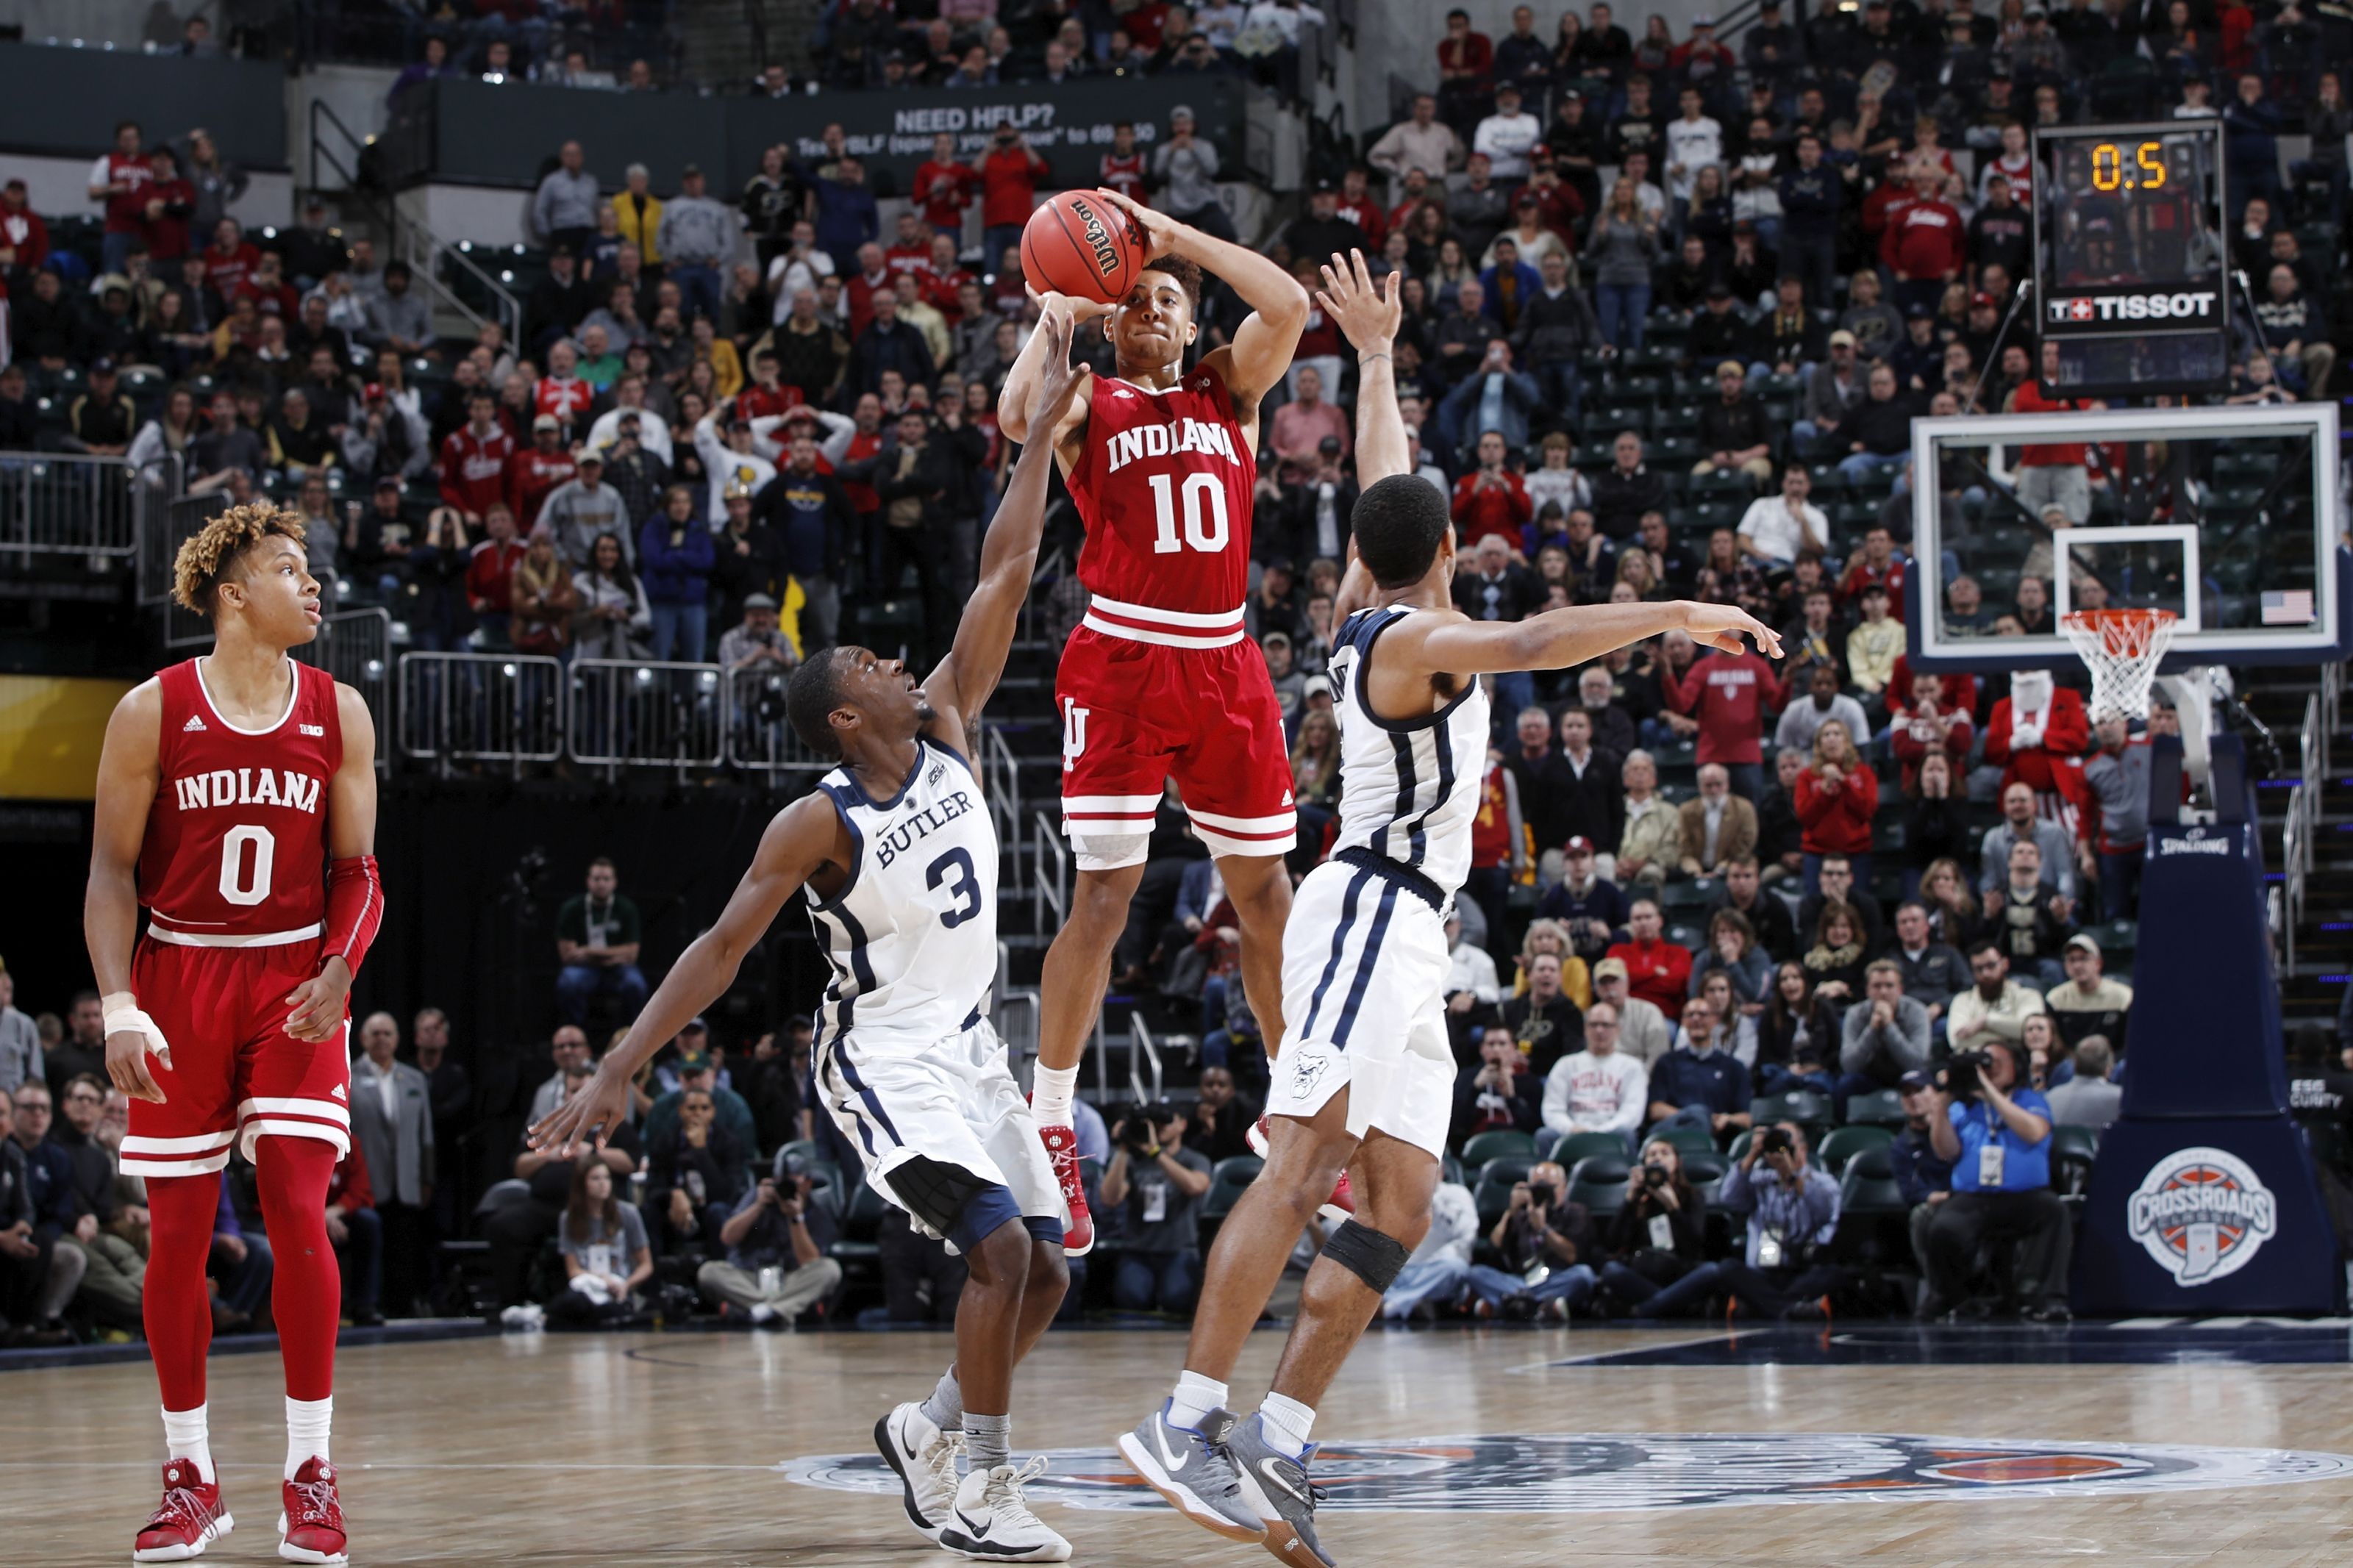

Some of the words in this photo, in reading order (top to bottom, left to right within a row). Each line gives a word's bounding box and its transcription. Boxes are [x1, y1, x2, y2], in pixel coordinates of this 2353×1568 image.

[796, 138, 830, 157] Tex
[1068, 126, 1088, 145] to
[1090, 122, 1156, 144] 6950
[895, 109, 965, 134] NEED
[972, 104, 1054, 130] HELP?
[2092, 142, 2167, 191] 0.5
[1070, 199, 1119, 277] Wilson
[2093, 292, 2216, 321] TISSOT
[1107, 417, 1240, 473] INDIANA
[1148, 472, 1229, 554] 10
[184, 723, 207, 731] adidas
[175, 768, 319, 814] INDIANA
[876, 791, 974, 870] BUTLER
[2160, 837, 2229, 856] SPALDING
[219, 824, 275, 906] 0
[926, 846, 982, 929] 3
[2135, 1186, 2270, 1235] CROSSROADS
